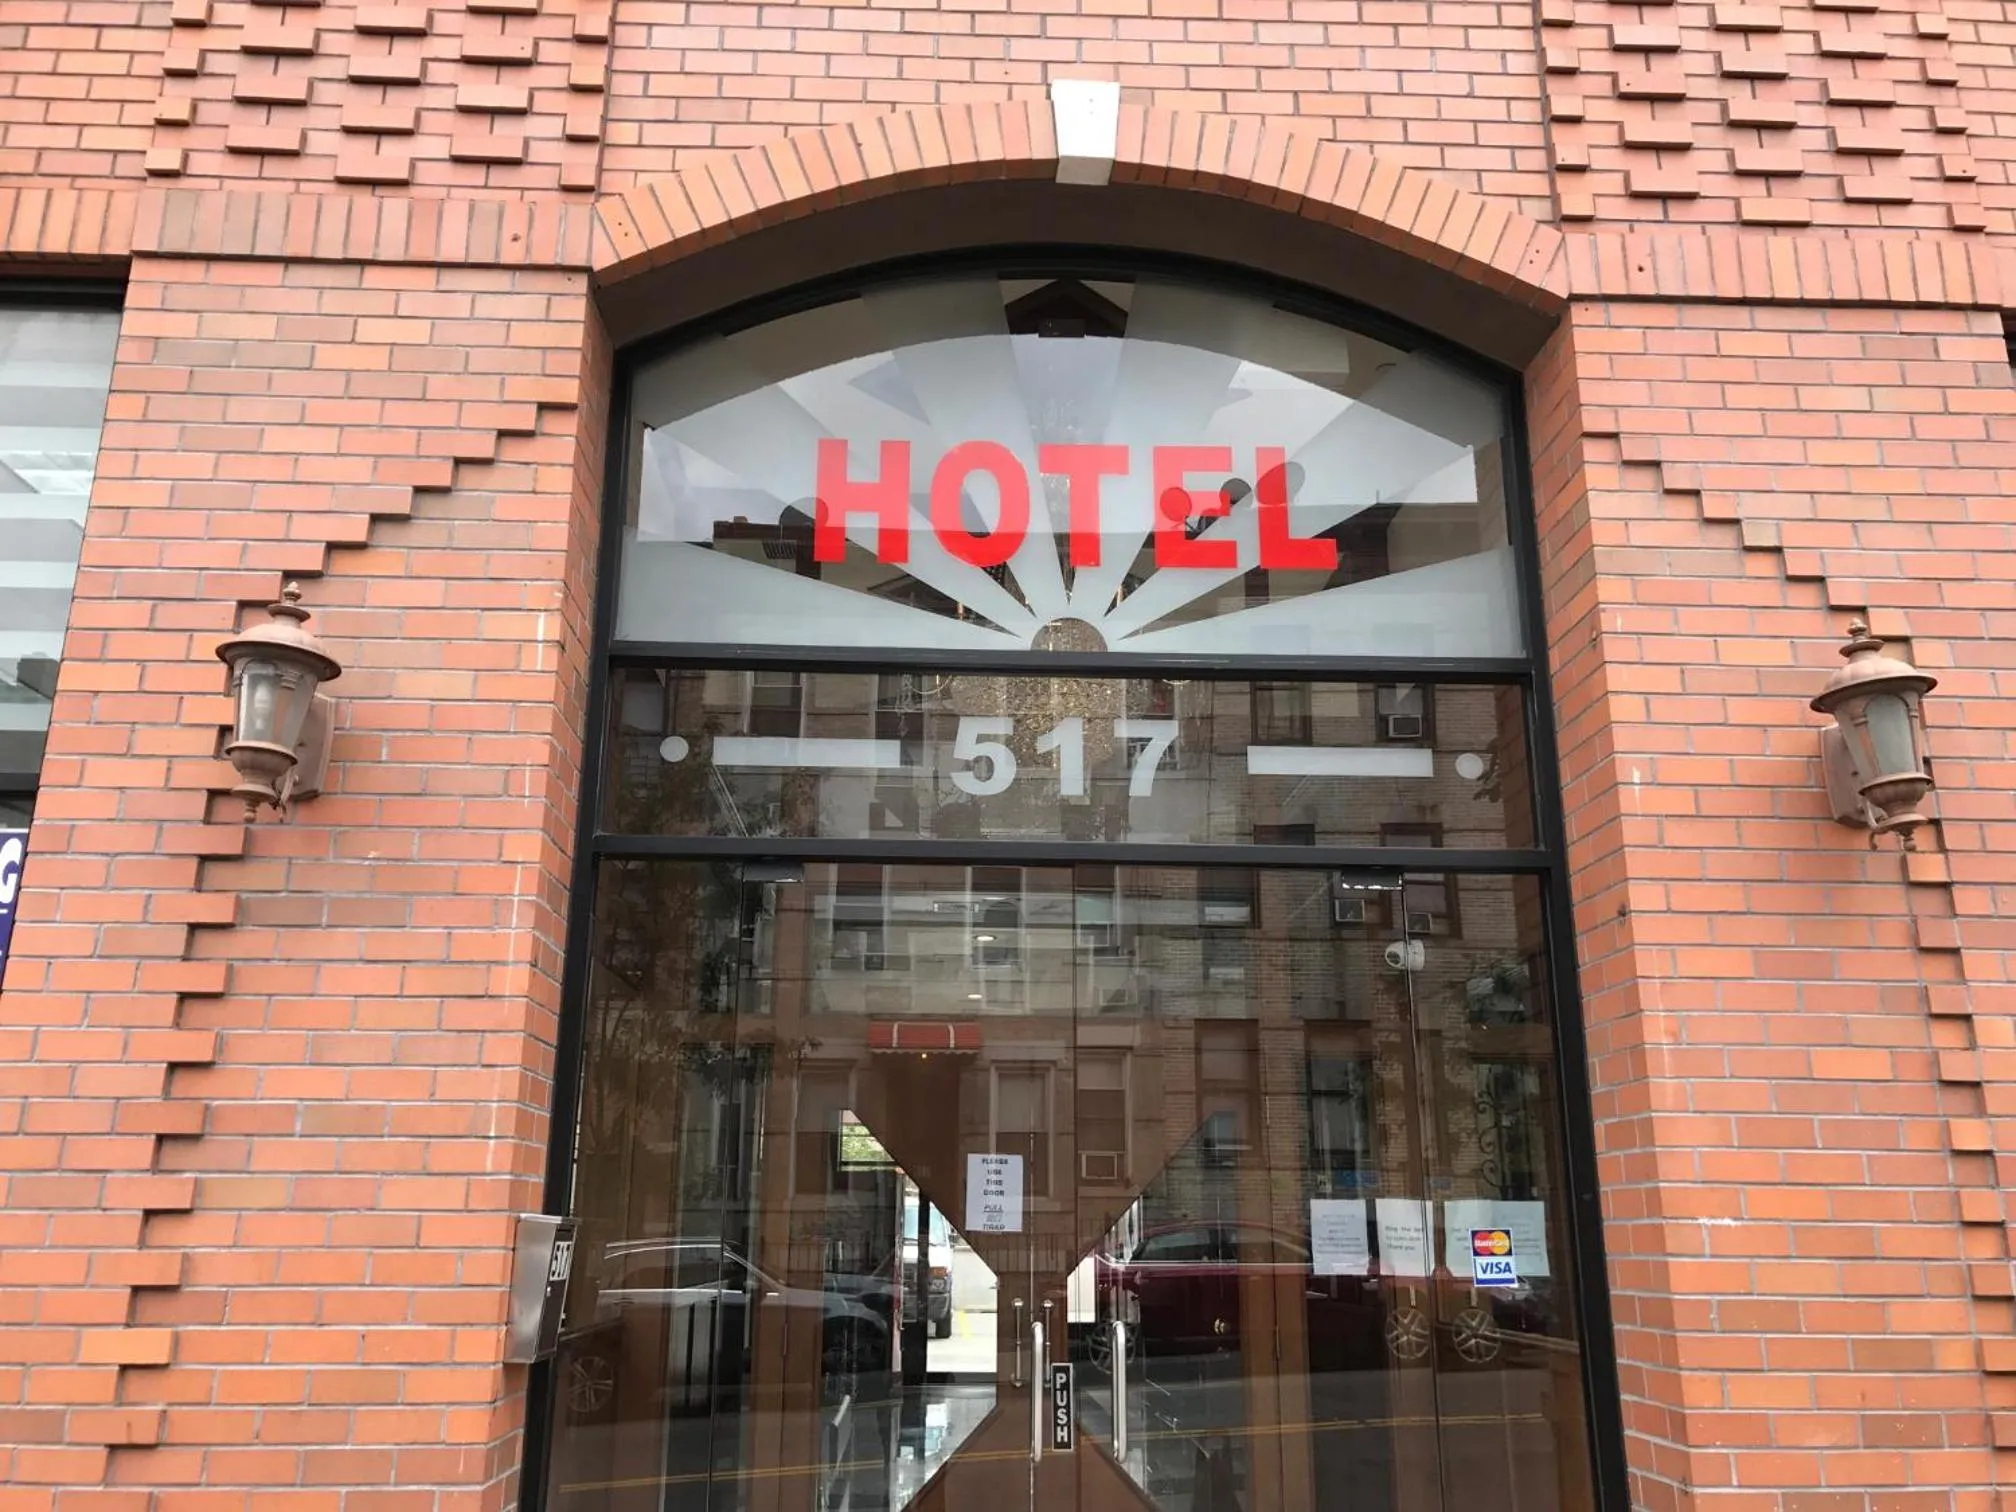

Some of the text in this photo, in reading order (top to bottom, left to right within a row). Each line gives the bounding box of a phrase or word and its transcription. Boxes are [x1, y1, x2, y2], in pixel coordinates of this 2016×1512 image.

[814, 438, 1338, 570] HOTEL
[951, 716, 1179, 797] 517
[1479, 1261, 1513, 1274] VISA
[1056, 1373, 1068, 1442] PUSH
